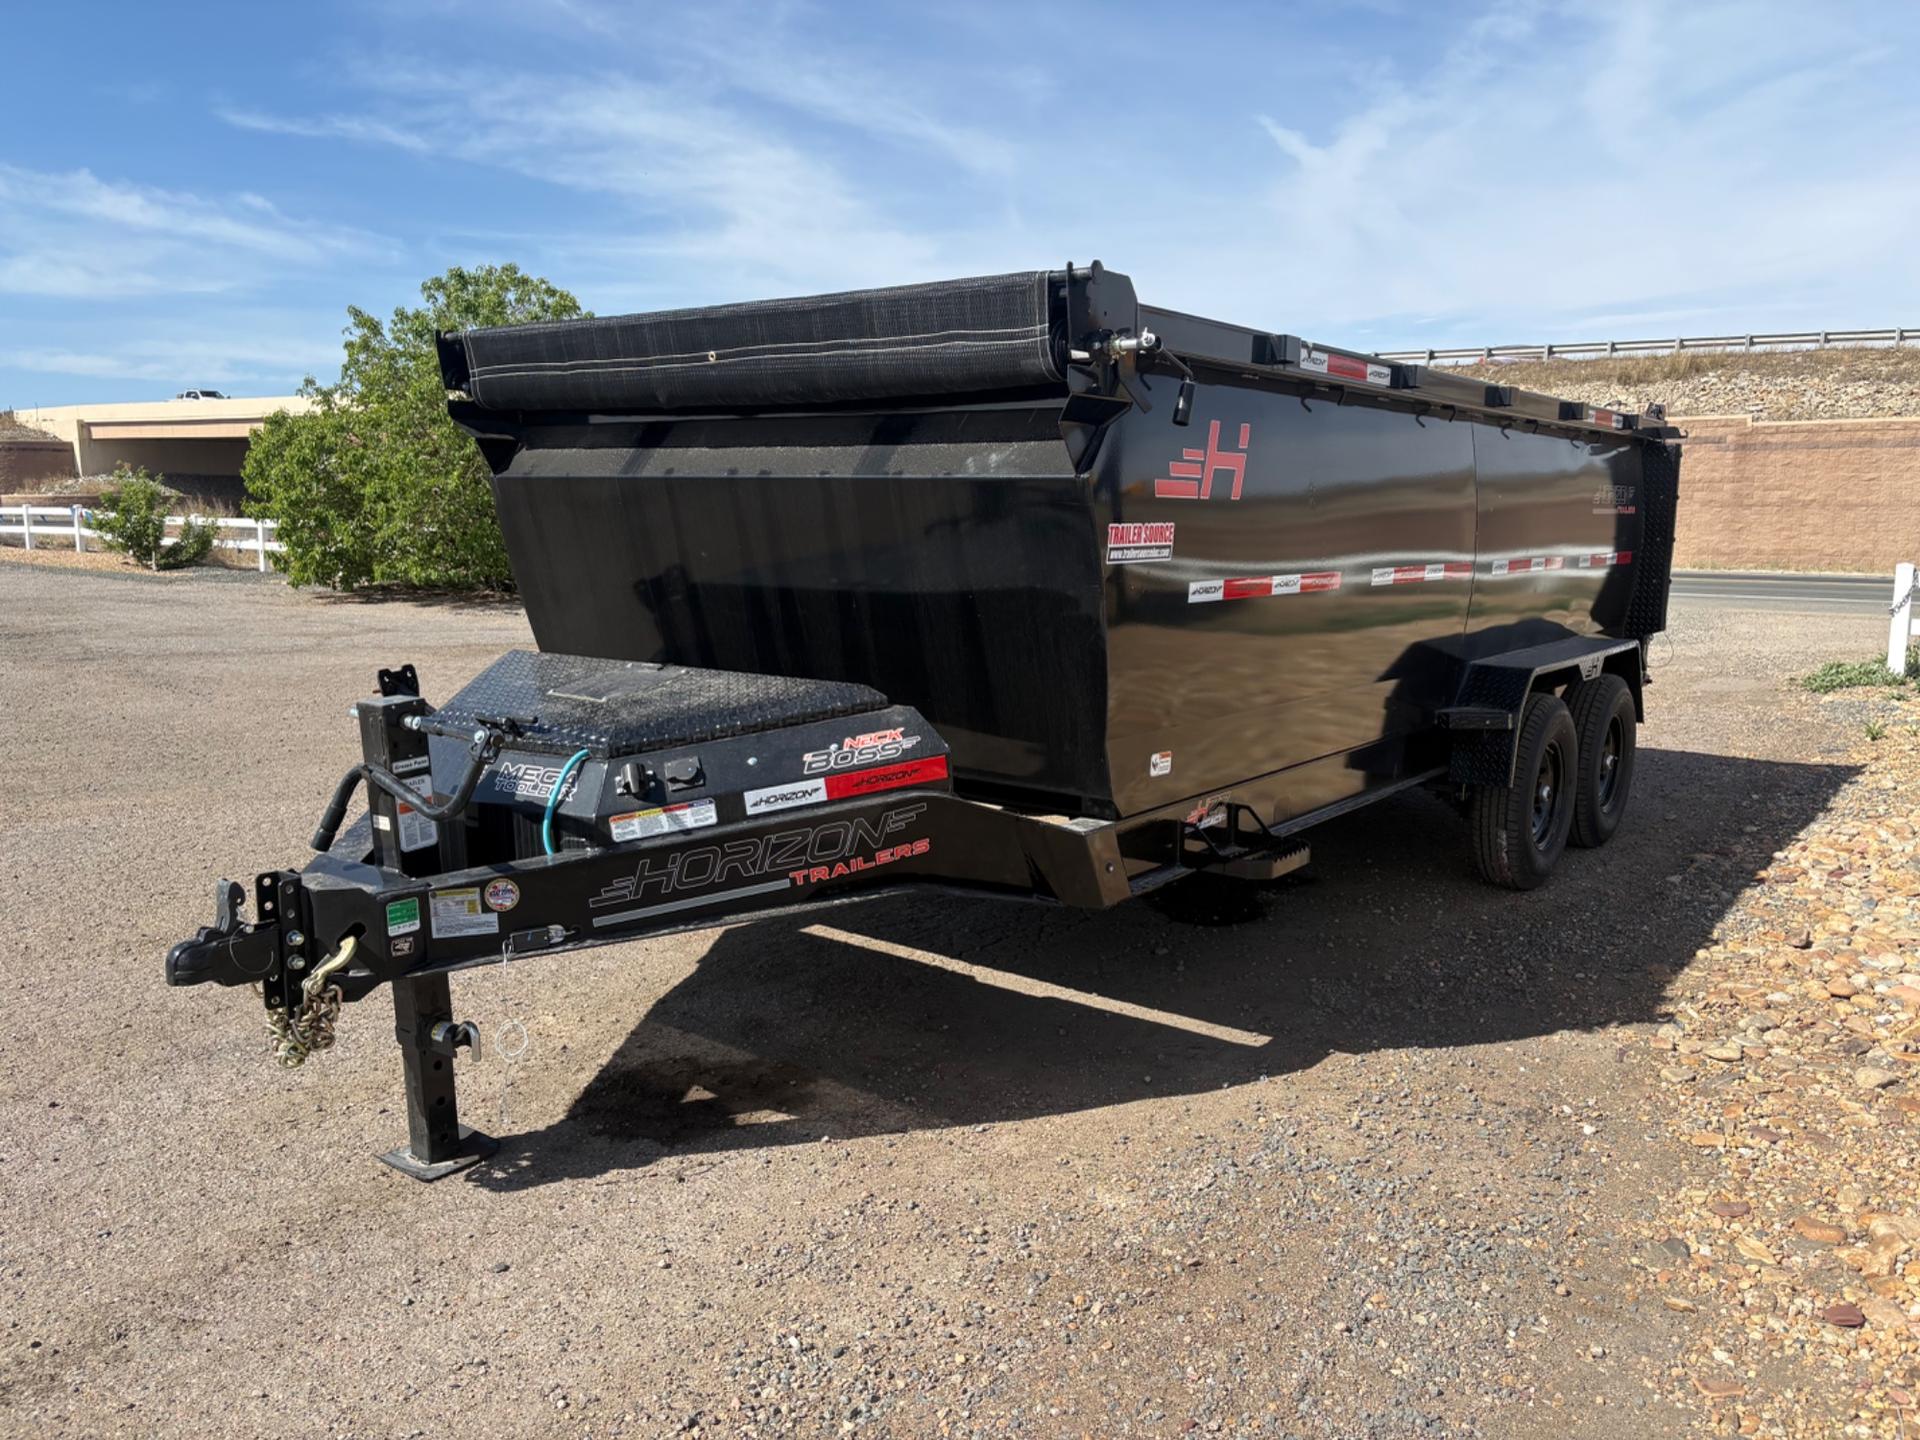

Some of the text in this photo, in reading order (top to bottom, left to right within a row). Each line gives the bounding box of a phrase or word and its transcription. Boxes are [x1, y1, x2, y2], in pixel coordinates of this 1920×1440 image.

[1109, 523, 1174, 545] TRAILER SOURCE
[843, 727, 904, 749] NECK
[803, 741, 912, 774] BOSS
[498, 761, 577, 788] MEGA
[859, 770, 914, 786] HORIZON
[754, 789, 818, 807] HORIZON
[602, 805, 917, 904] HORIZON
[789, 838, 931, 886] TRAILERS
